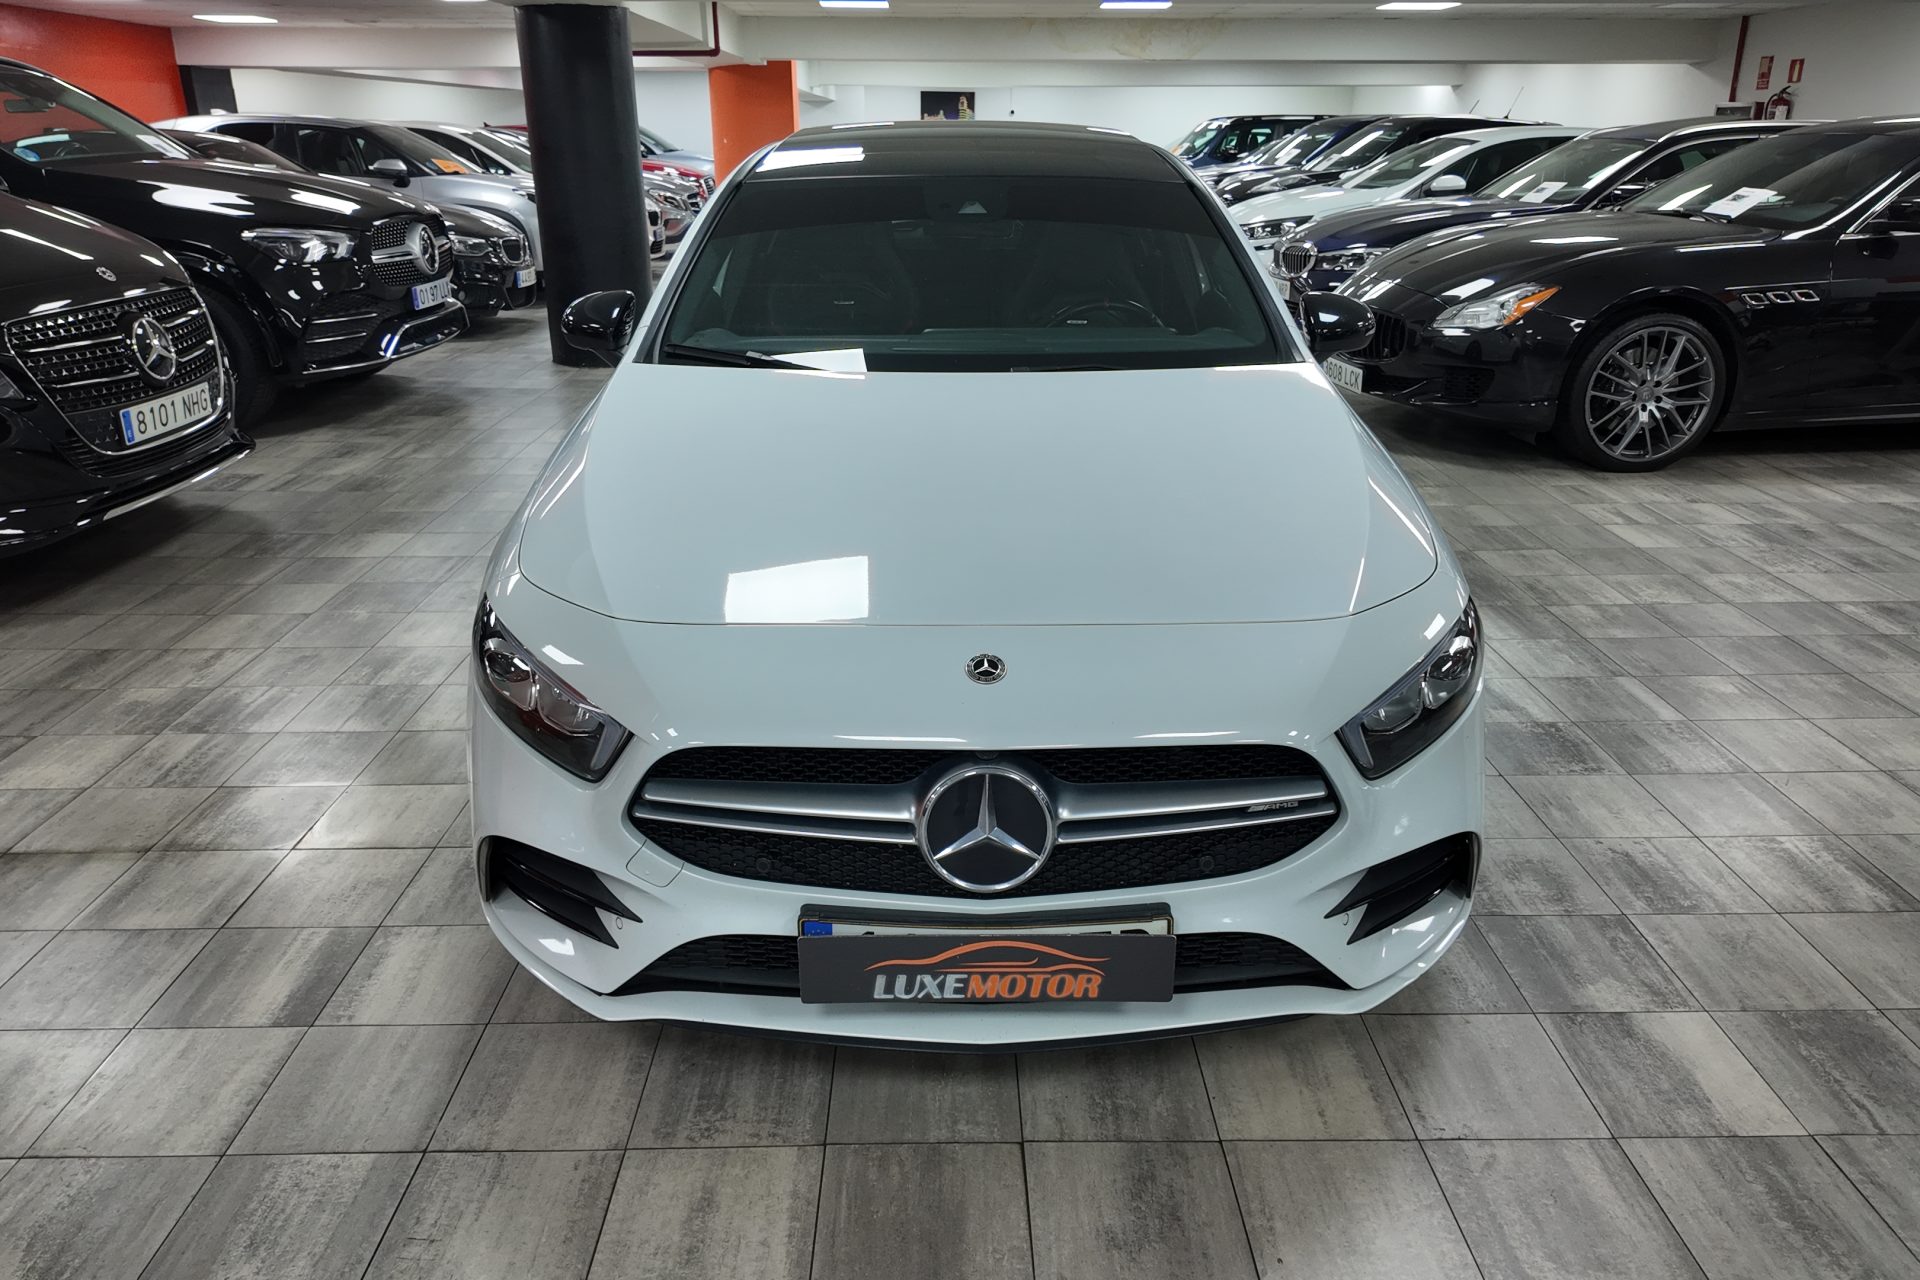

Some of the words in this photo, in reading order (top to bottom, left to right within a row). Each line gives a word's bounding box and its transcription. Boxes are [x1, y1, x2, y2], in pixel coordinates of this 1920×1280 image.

[420, 285, 437, 305] 0197
[1325, 360, 1343, 382] 3608
[1344, 367, 1360, 391] LCK
[137, 400, 177, 434] 8101
[182, 388, 208, 419] NHG
[873, 974, 1102, 999] LUXEMOTOR
